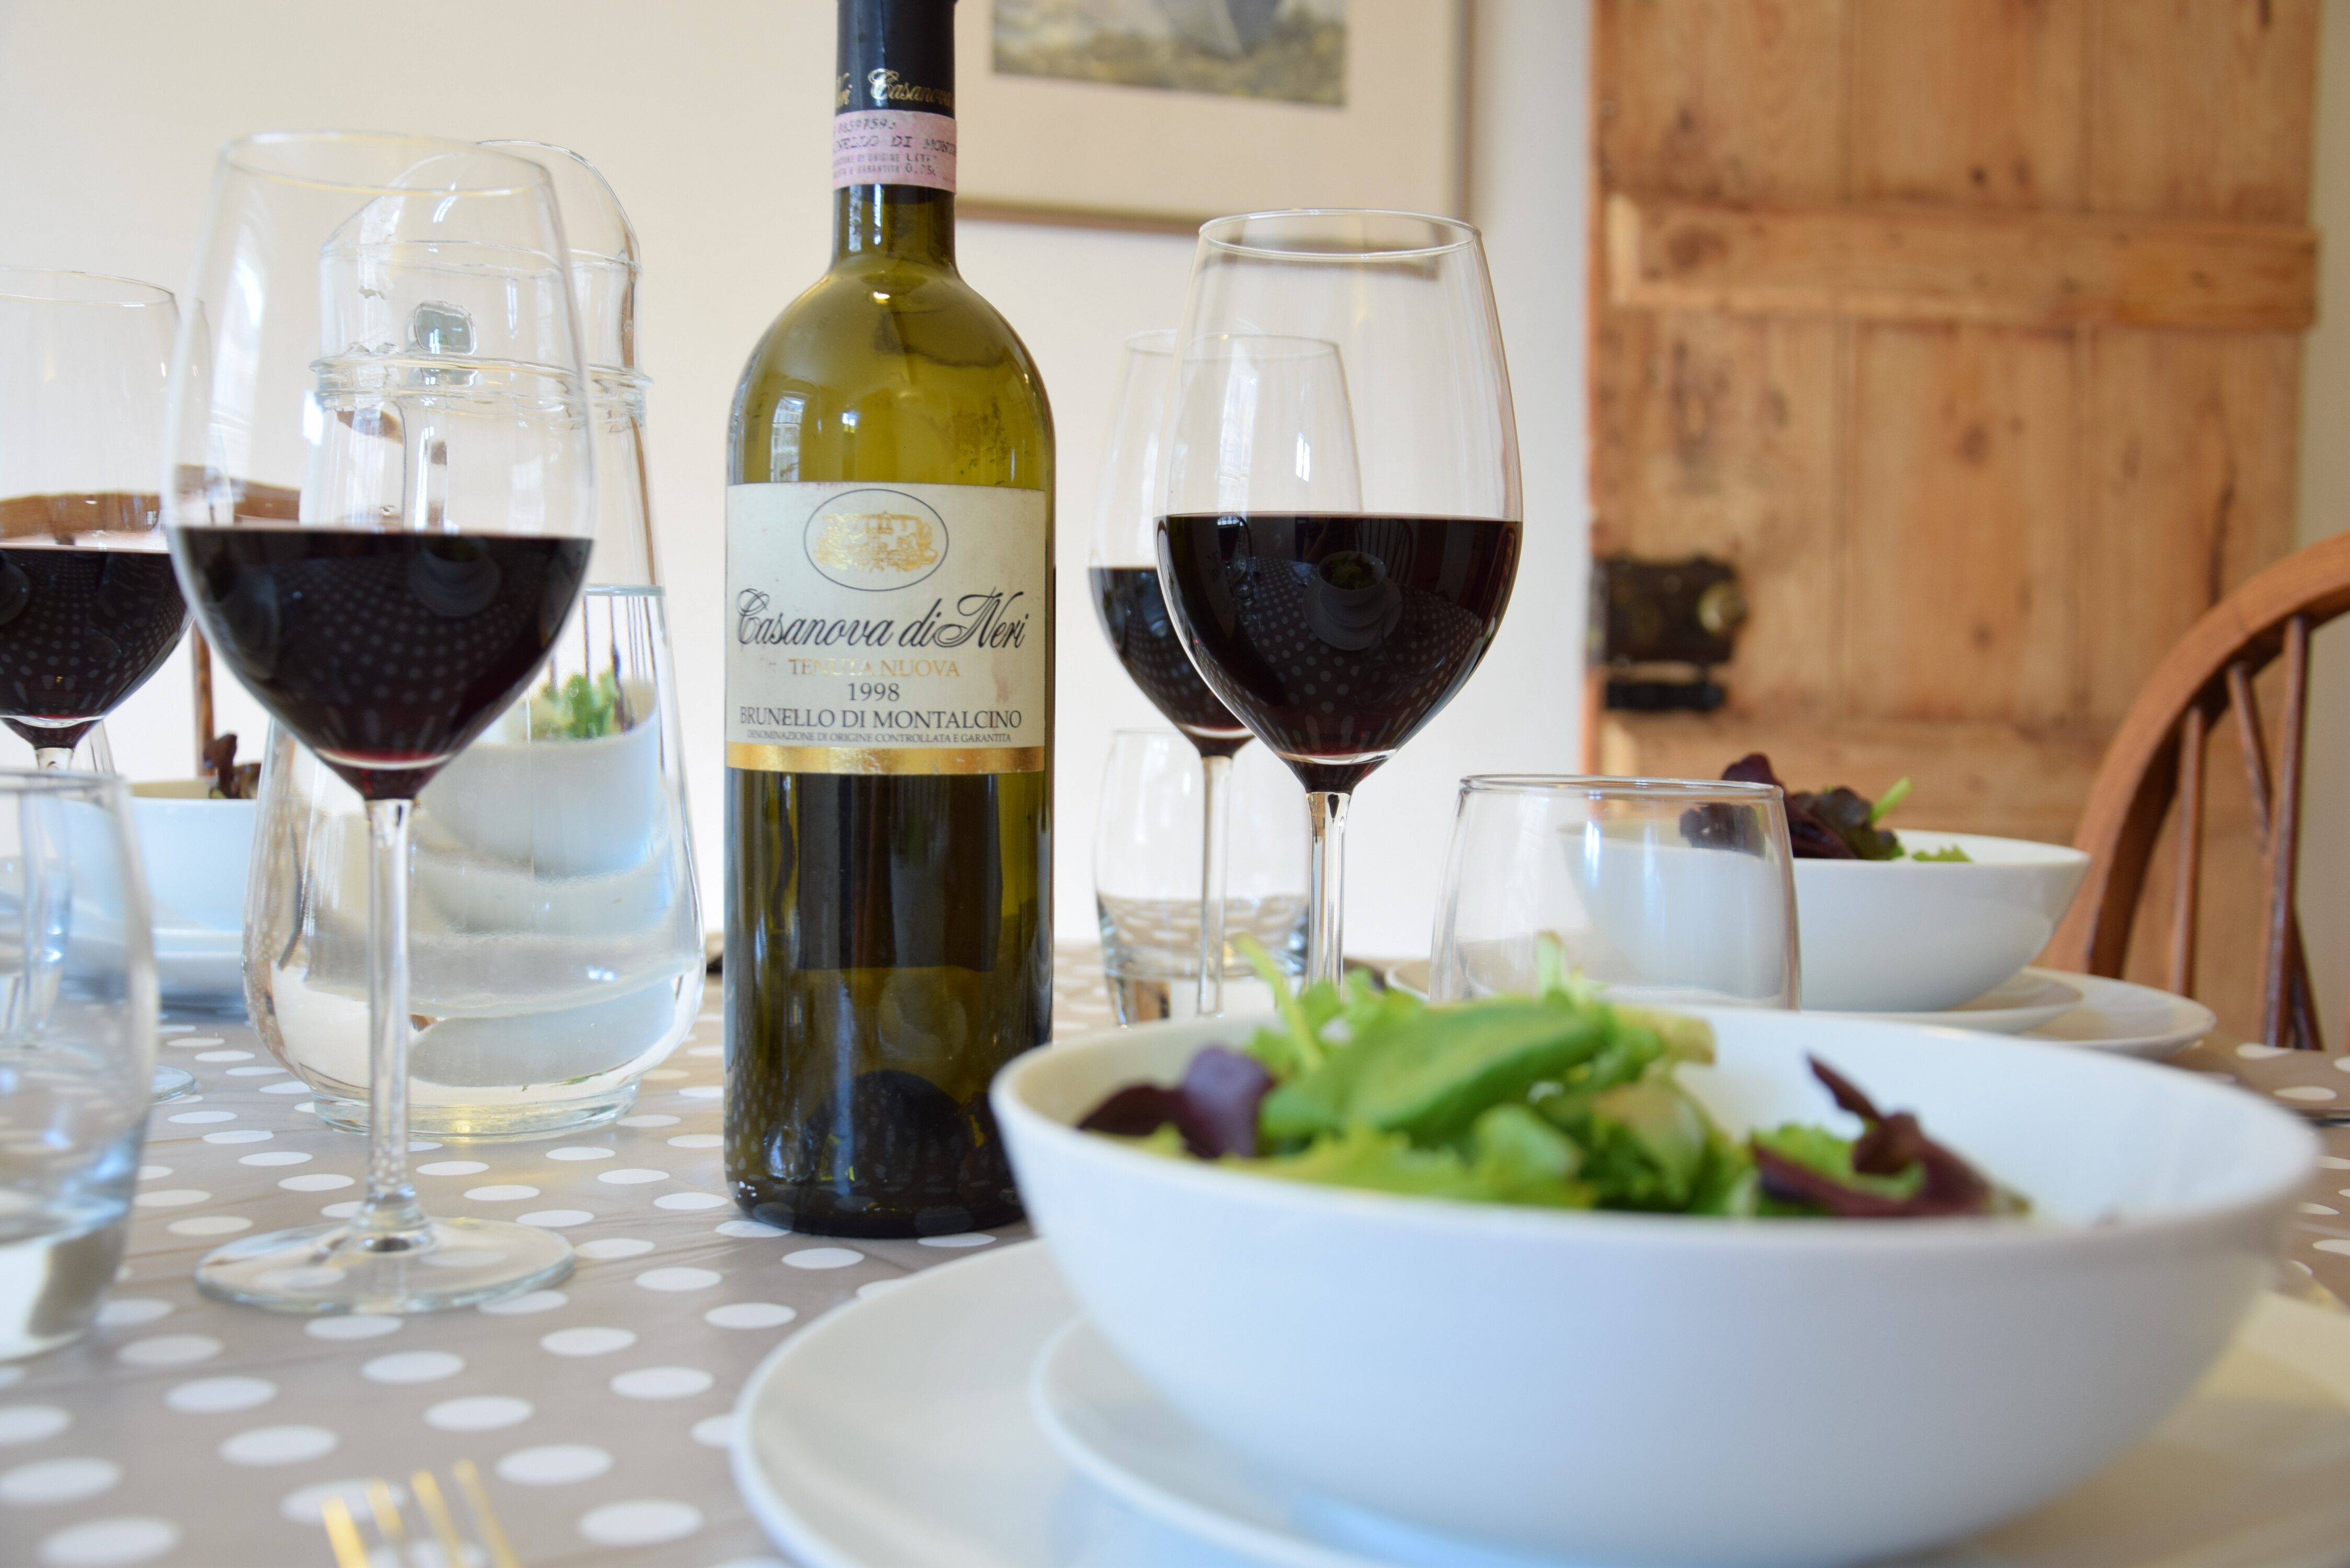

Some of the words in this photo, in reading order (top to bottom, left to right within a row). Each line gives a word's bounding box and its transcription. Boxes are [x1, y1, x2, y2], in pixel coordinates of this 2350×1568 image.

[890, 135, 913, 148] DI
[736, 589, 894, 647] Casanova
[898, 598, 942, 647] di
[934, 586, 1029, 648] Neri
[789, 658, 875, 676] TENUTA
[880, 659, 961, 677] NUOVA
[847, 682, 900, 701] 1998
[740, 706, 835, 727] BRUNELLO
[842, 710, 866, 728] DI
[873, 710, 1022, 729] MONTALCINO
[747, 729, 815, 741] DENOMINAZIONE
[817, 732, 827, 741] DI
[831, 732, 873, 742] ORIGINE
[875, 733, 951, 743] CONTROLLATA
[953, 734, 959, 742] E
[961, 733, 1012, 742] GARANTITA
